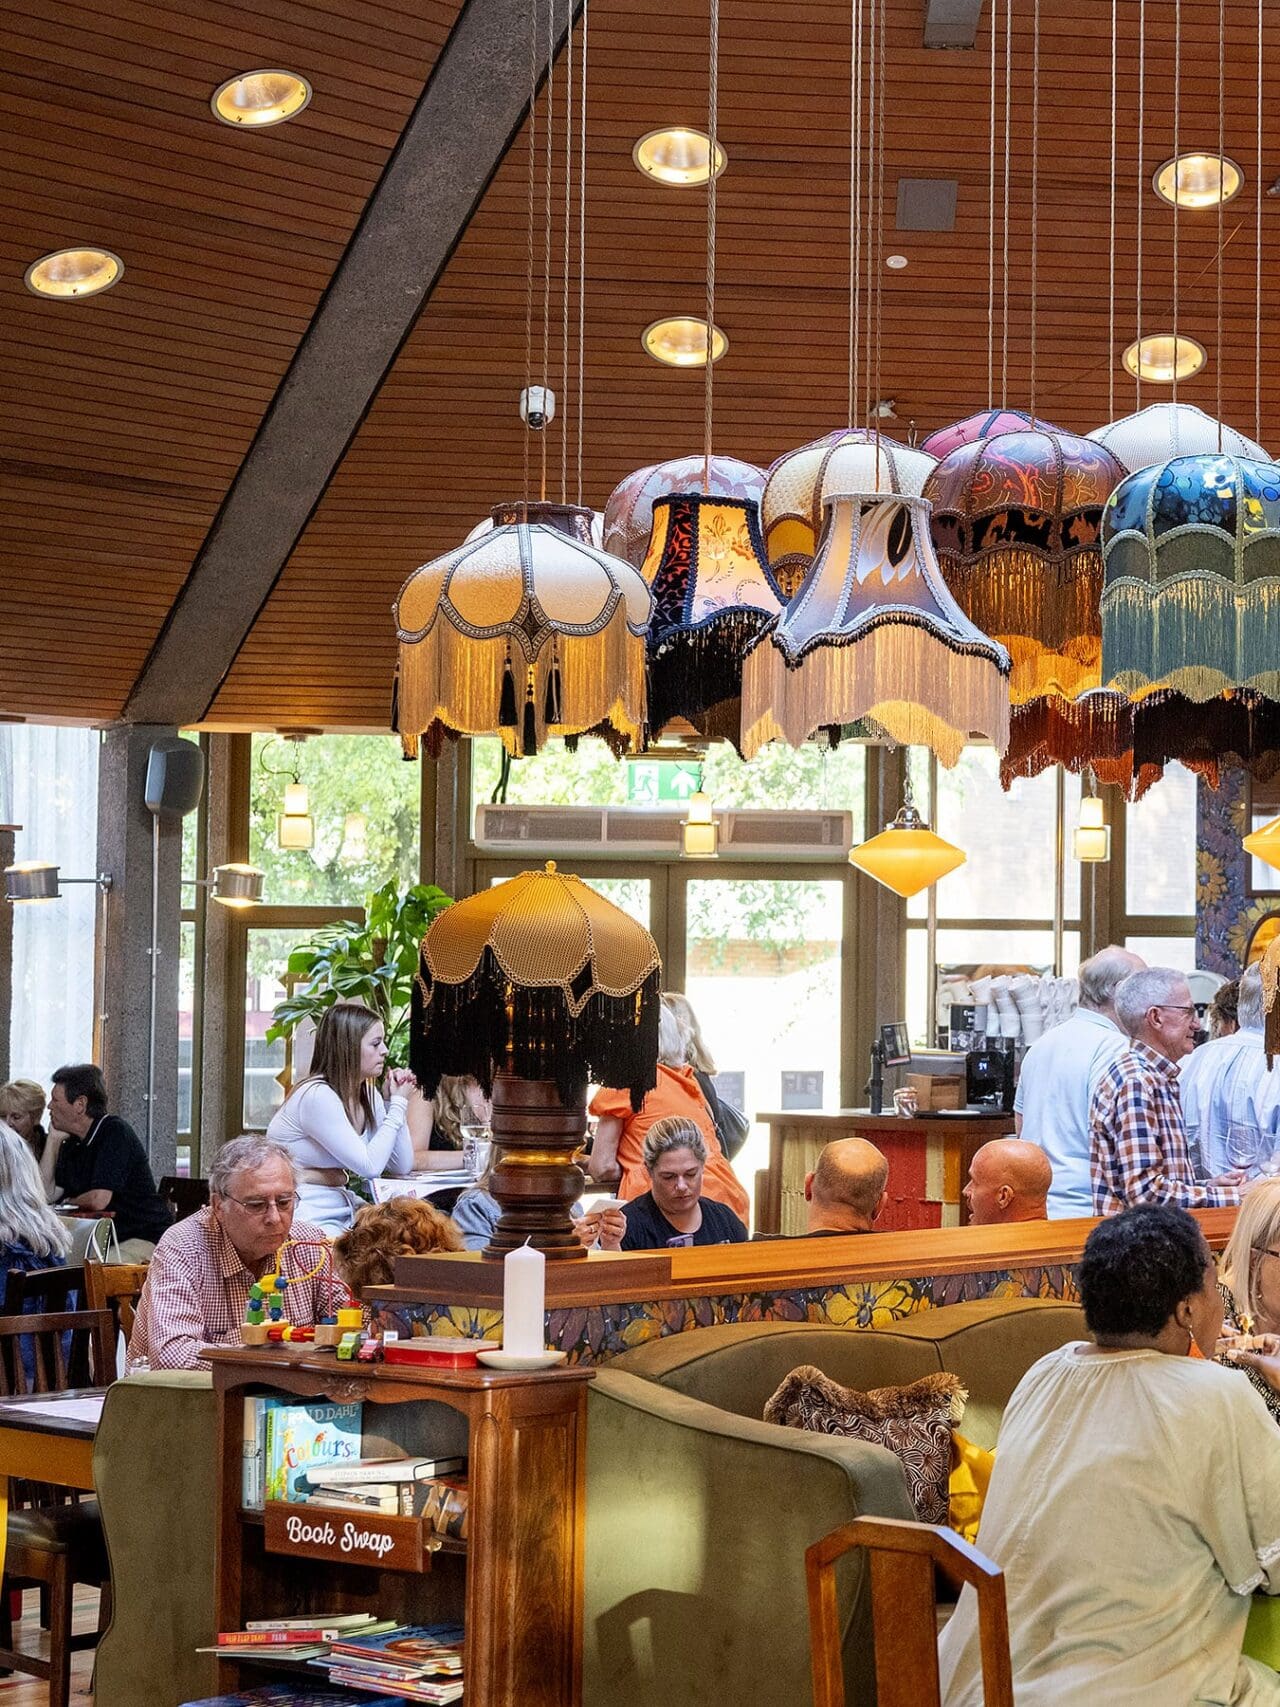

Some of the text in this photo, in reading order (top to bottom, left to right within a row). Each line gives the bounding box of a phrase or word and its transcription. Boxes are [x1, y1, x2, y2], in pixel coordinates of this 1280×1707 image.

[326, 1406, 357, 1420] DAHL
[287, 1439, 351, 1469] Colours
[286, 1516, 395, 1558] Book Swap
